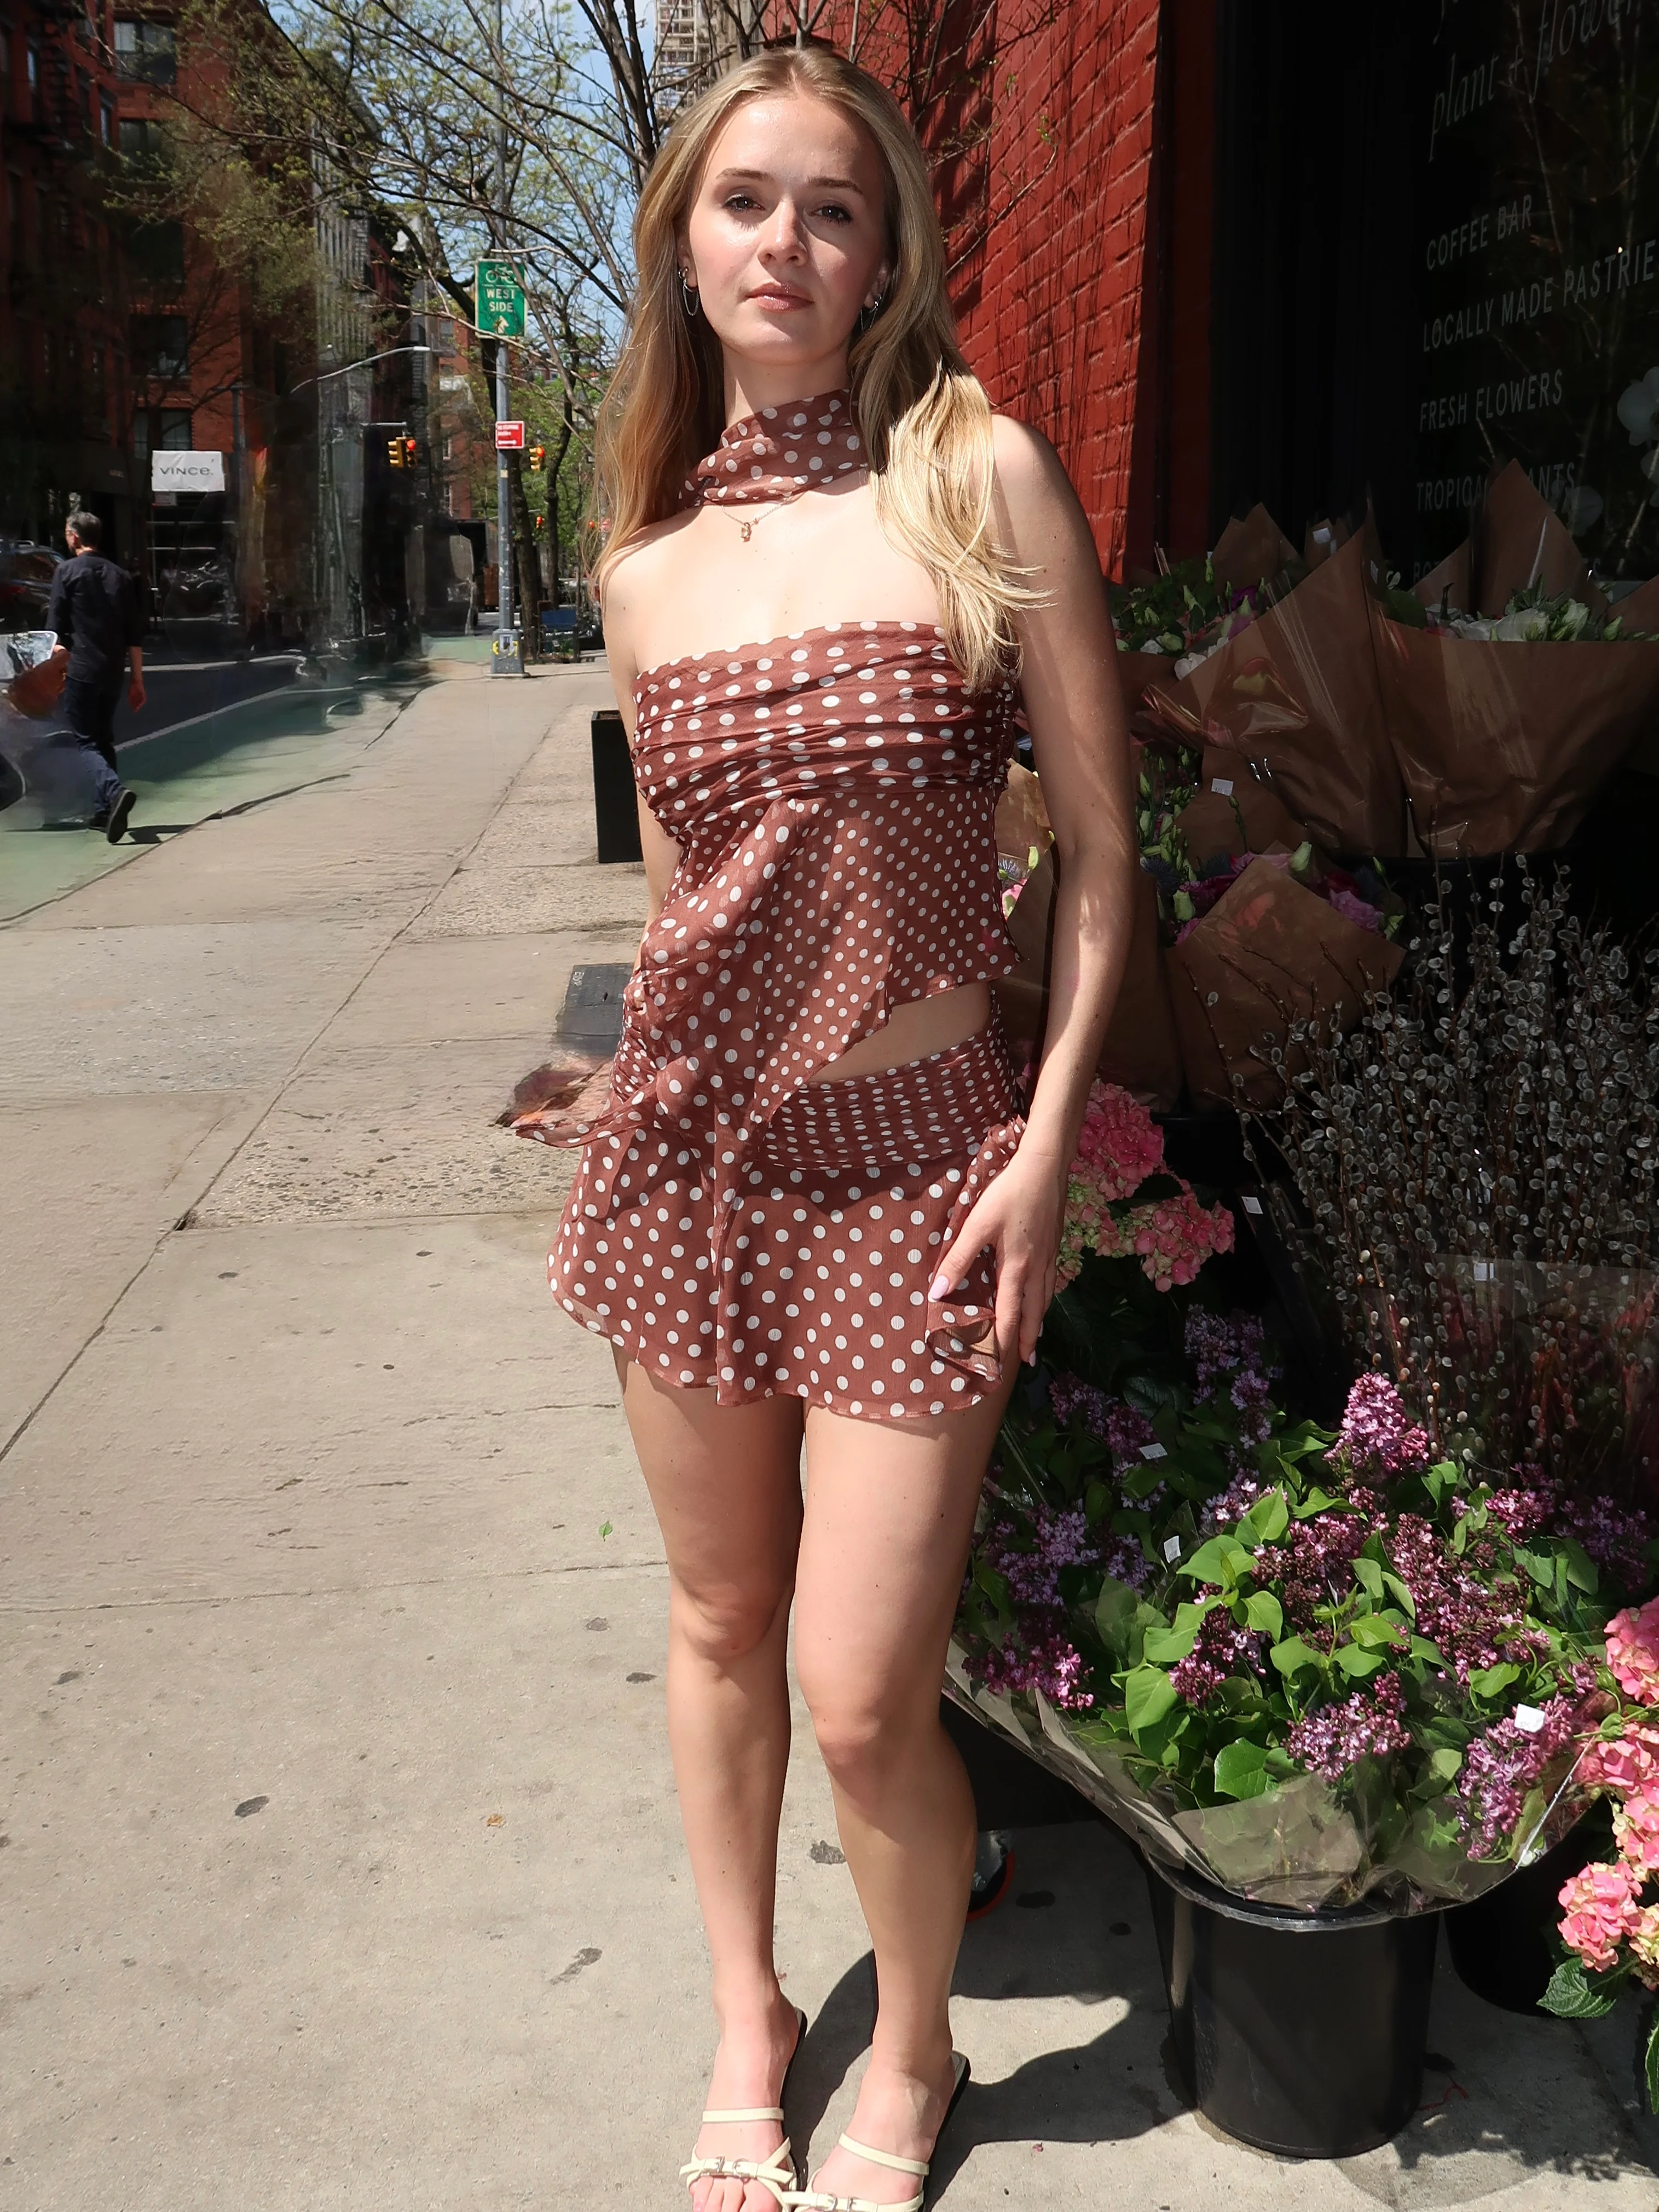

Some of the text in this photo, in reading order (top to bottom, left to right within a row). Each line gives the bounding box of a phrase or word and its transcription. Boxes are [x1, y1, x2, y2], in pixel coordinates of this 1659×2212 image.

[1428, 53, 1499, 164] plant
[1531, 0, 1631, 101] flow
[1426, 194, 1532, 271] COFFEE BAR
[487, 288, 515, 299] WEST
[489, 301, 513, 313] SIDE
[1423, 239, 1657, 353] LOCALLY MADE PASTRIE
[1419, 368, 1563, 433] FRESH FLOWERS
